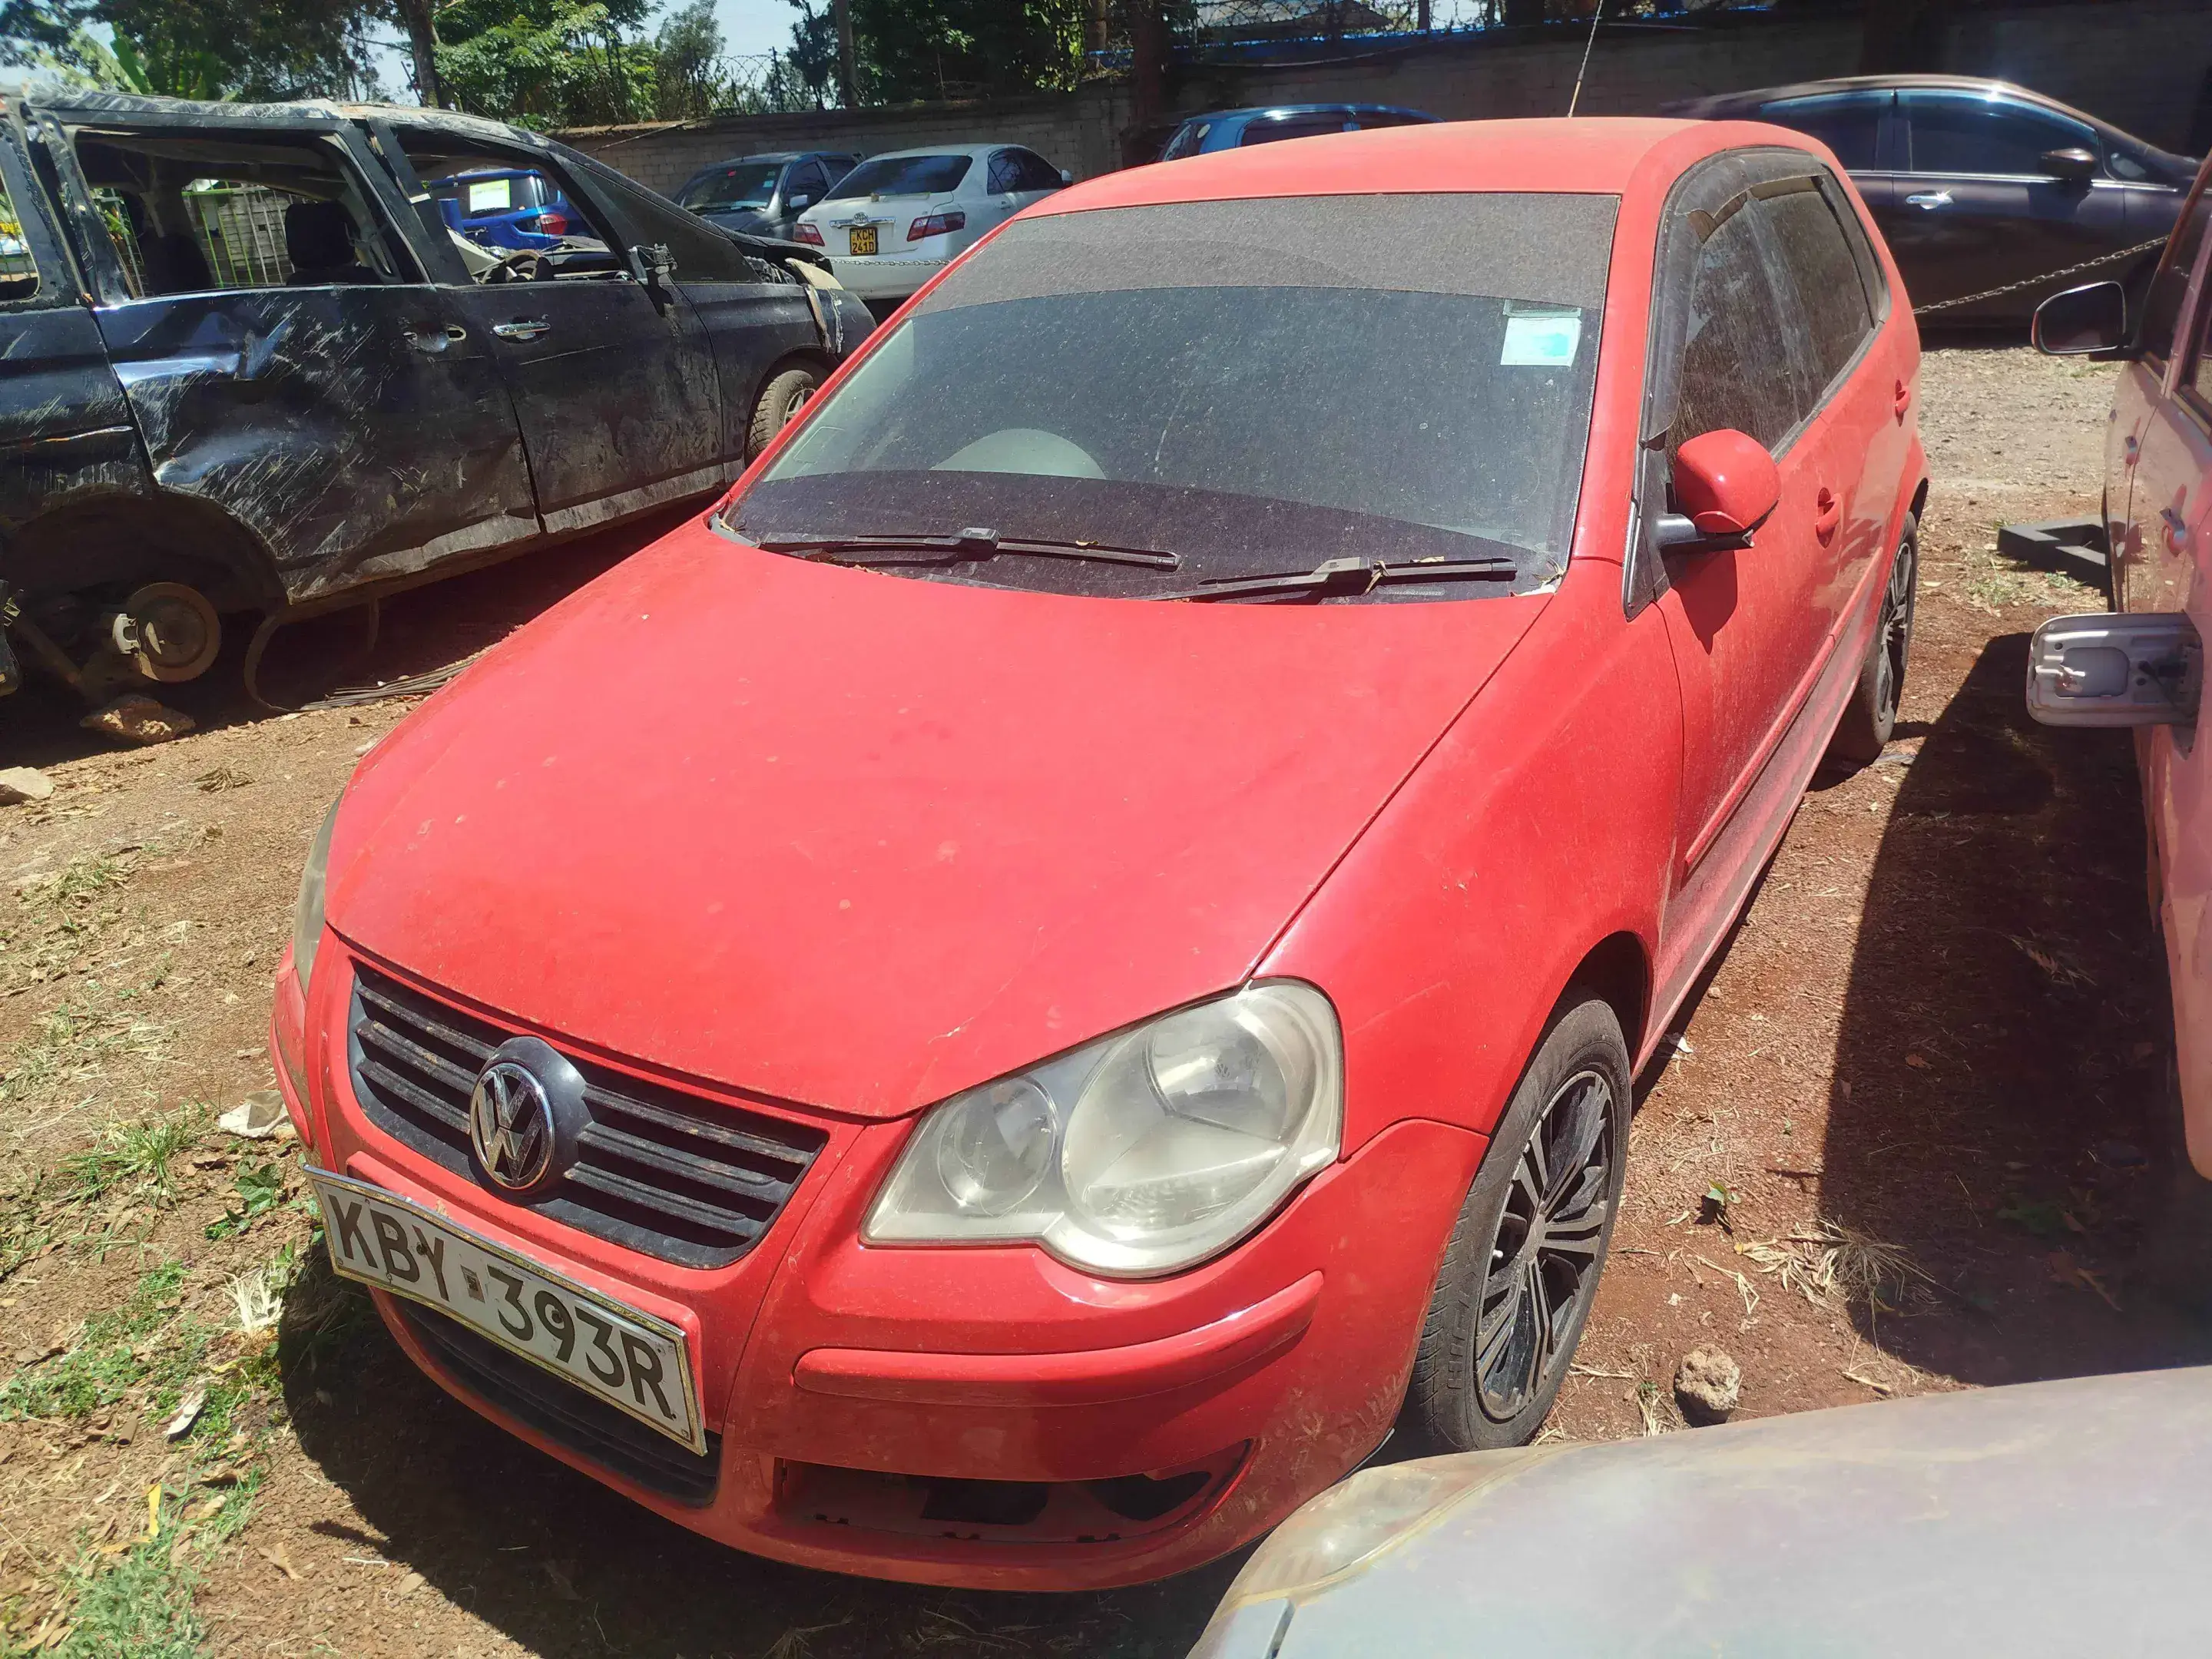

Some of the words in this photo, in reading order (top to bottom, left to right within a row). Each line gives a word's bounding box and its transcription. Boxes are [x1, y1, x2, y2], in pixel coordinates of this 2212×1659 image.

[856, 229, 874, 241] KCH
[853, 242, 874, 253] 241D
[328, 1194, 450, 1302] KBY
[487, 1264, 675, 1420] 393R
